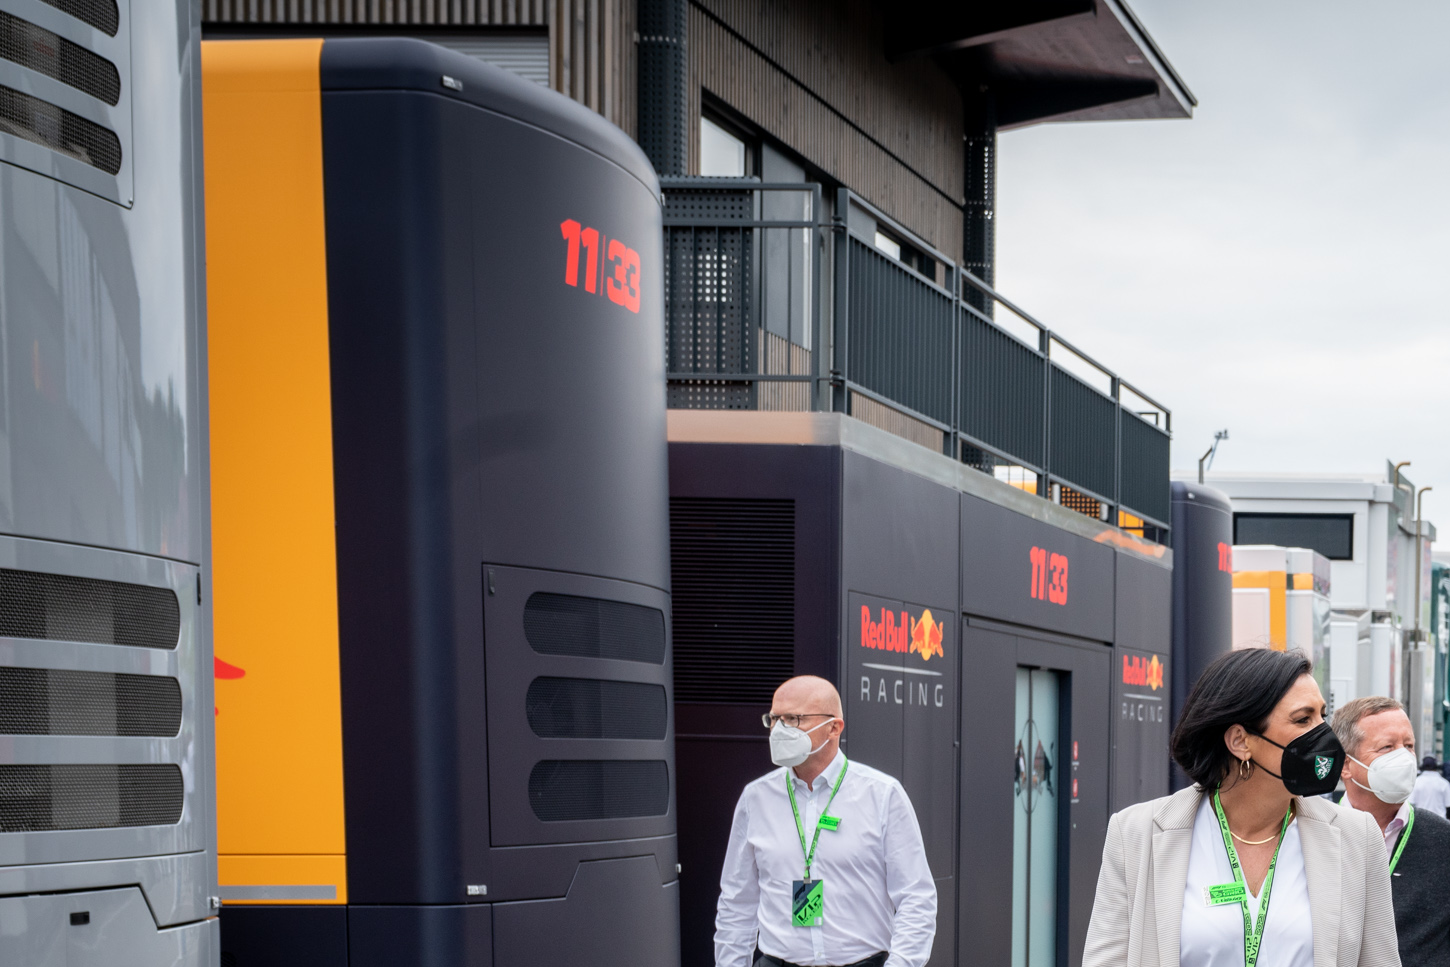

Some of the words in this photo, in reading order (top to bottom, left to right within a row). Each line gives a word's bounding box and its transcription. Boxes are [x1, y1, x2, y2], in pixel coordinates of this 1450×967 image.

[861, 605, 885, 650] Red
[886, 609, 908, 654] Bull
[861, 676, 943, 708] RACING
[1122, 702, 1163, 723] RACING
